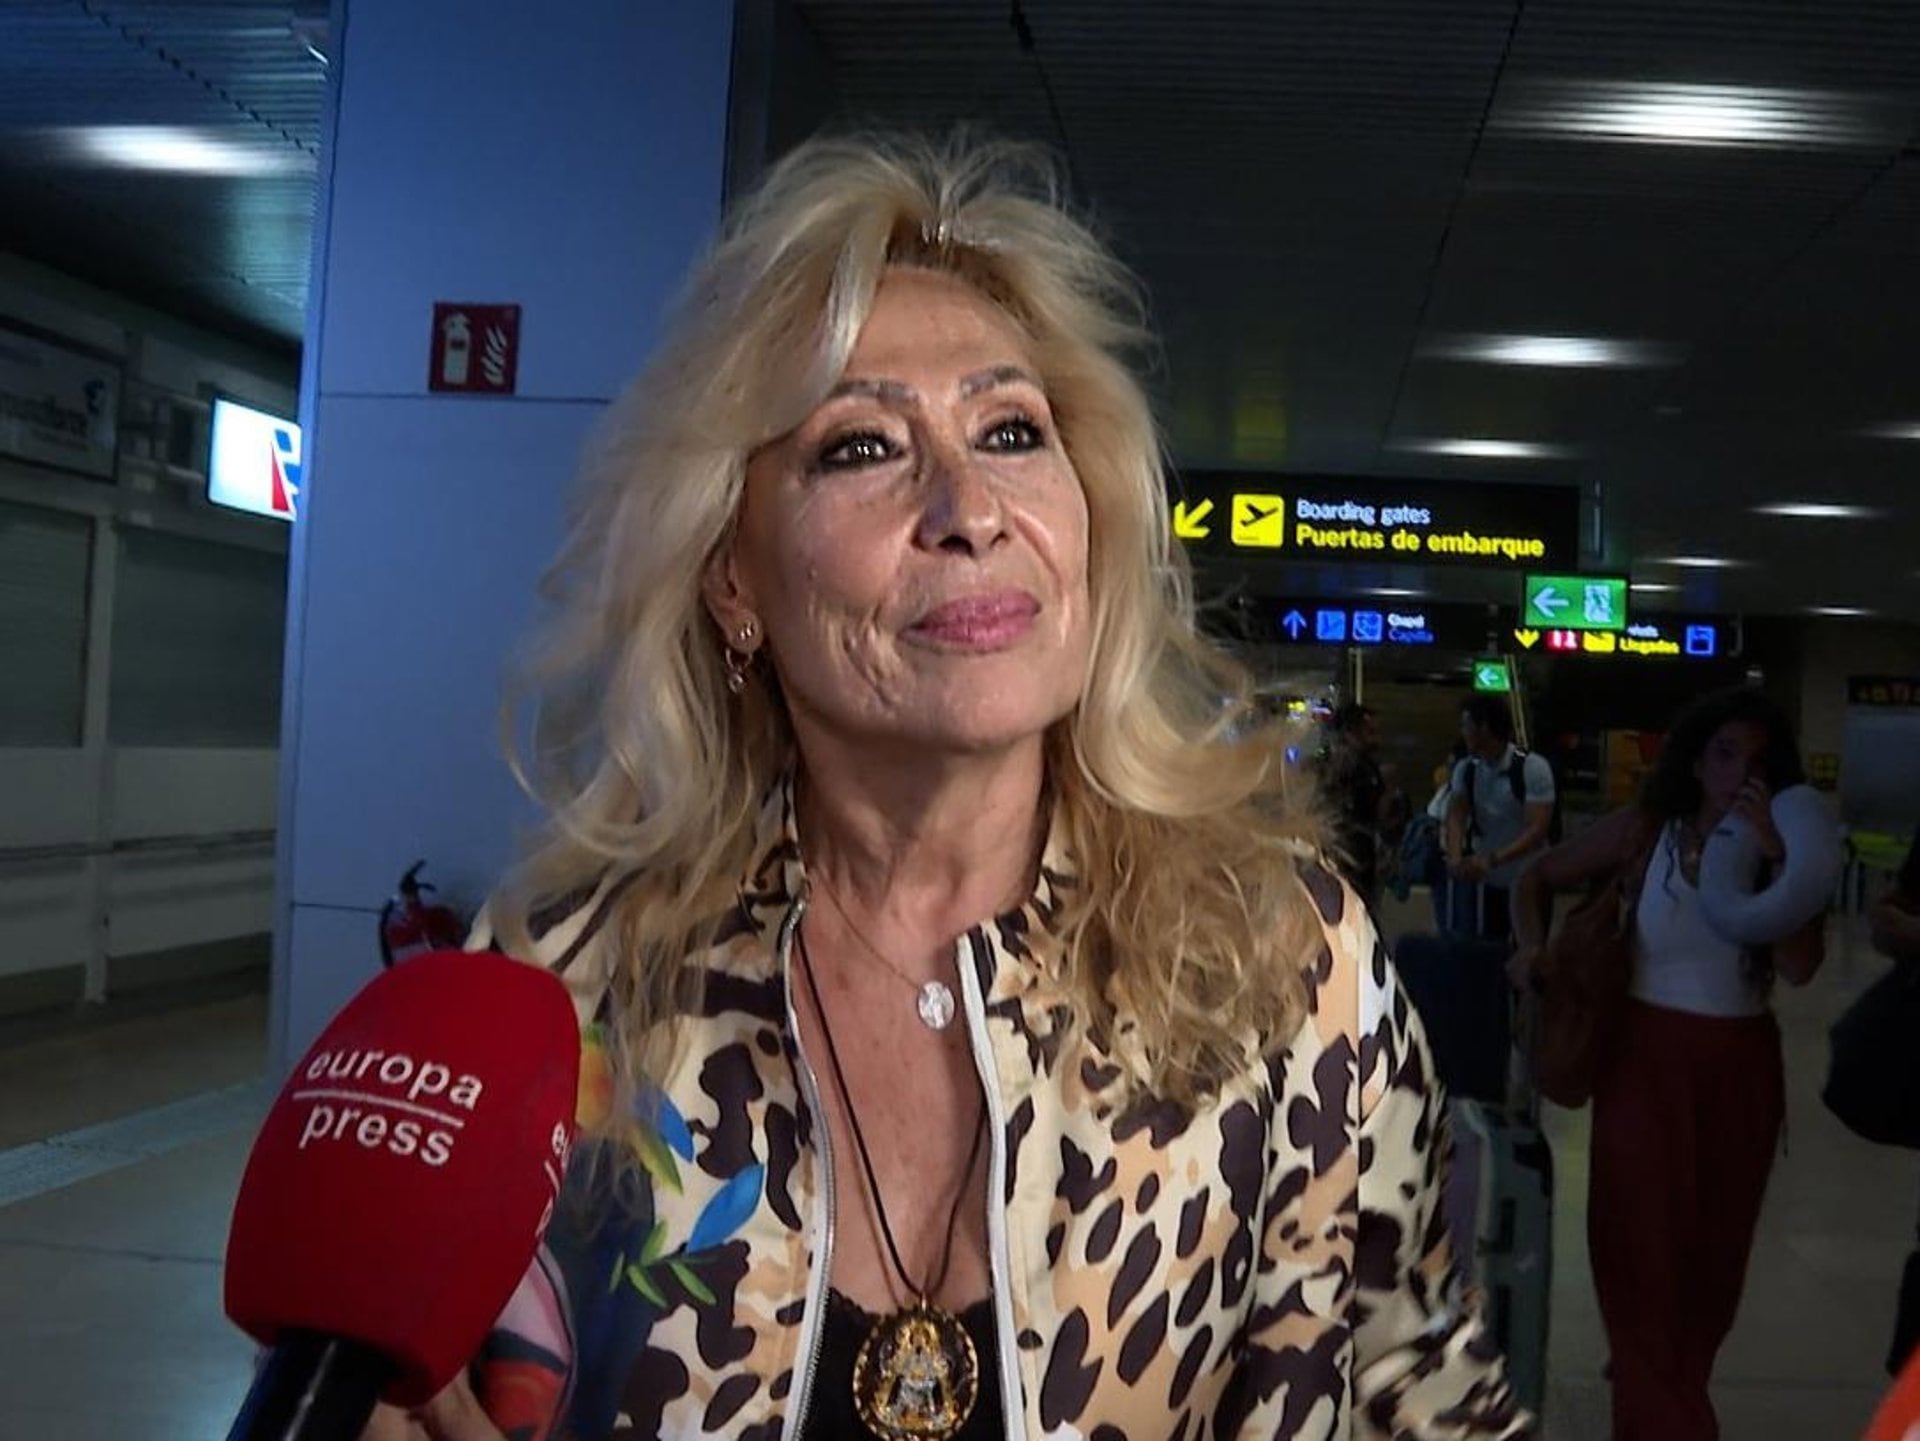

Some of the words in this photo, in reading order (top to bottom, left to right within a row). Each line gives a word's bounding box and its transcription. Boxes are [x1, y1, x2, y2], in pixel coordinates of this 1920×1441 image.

[1296, 499, 1375, 528] Boarding
[1382, 507, 1431, 527] gates
[1296, 524, 1384, 549] Puertas
[1394, 527, 1418, 550] de
[1428, 533, 1545, 557] embarque
[307, 1049, 483, 1110] europa
[299, 1104, 454, 1166] press
